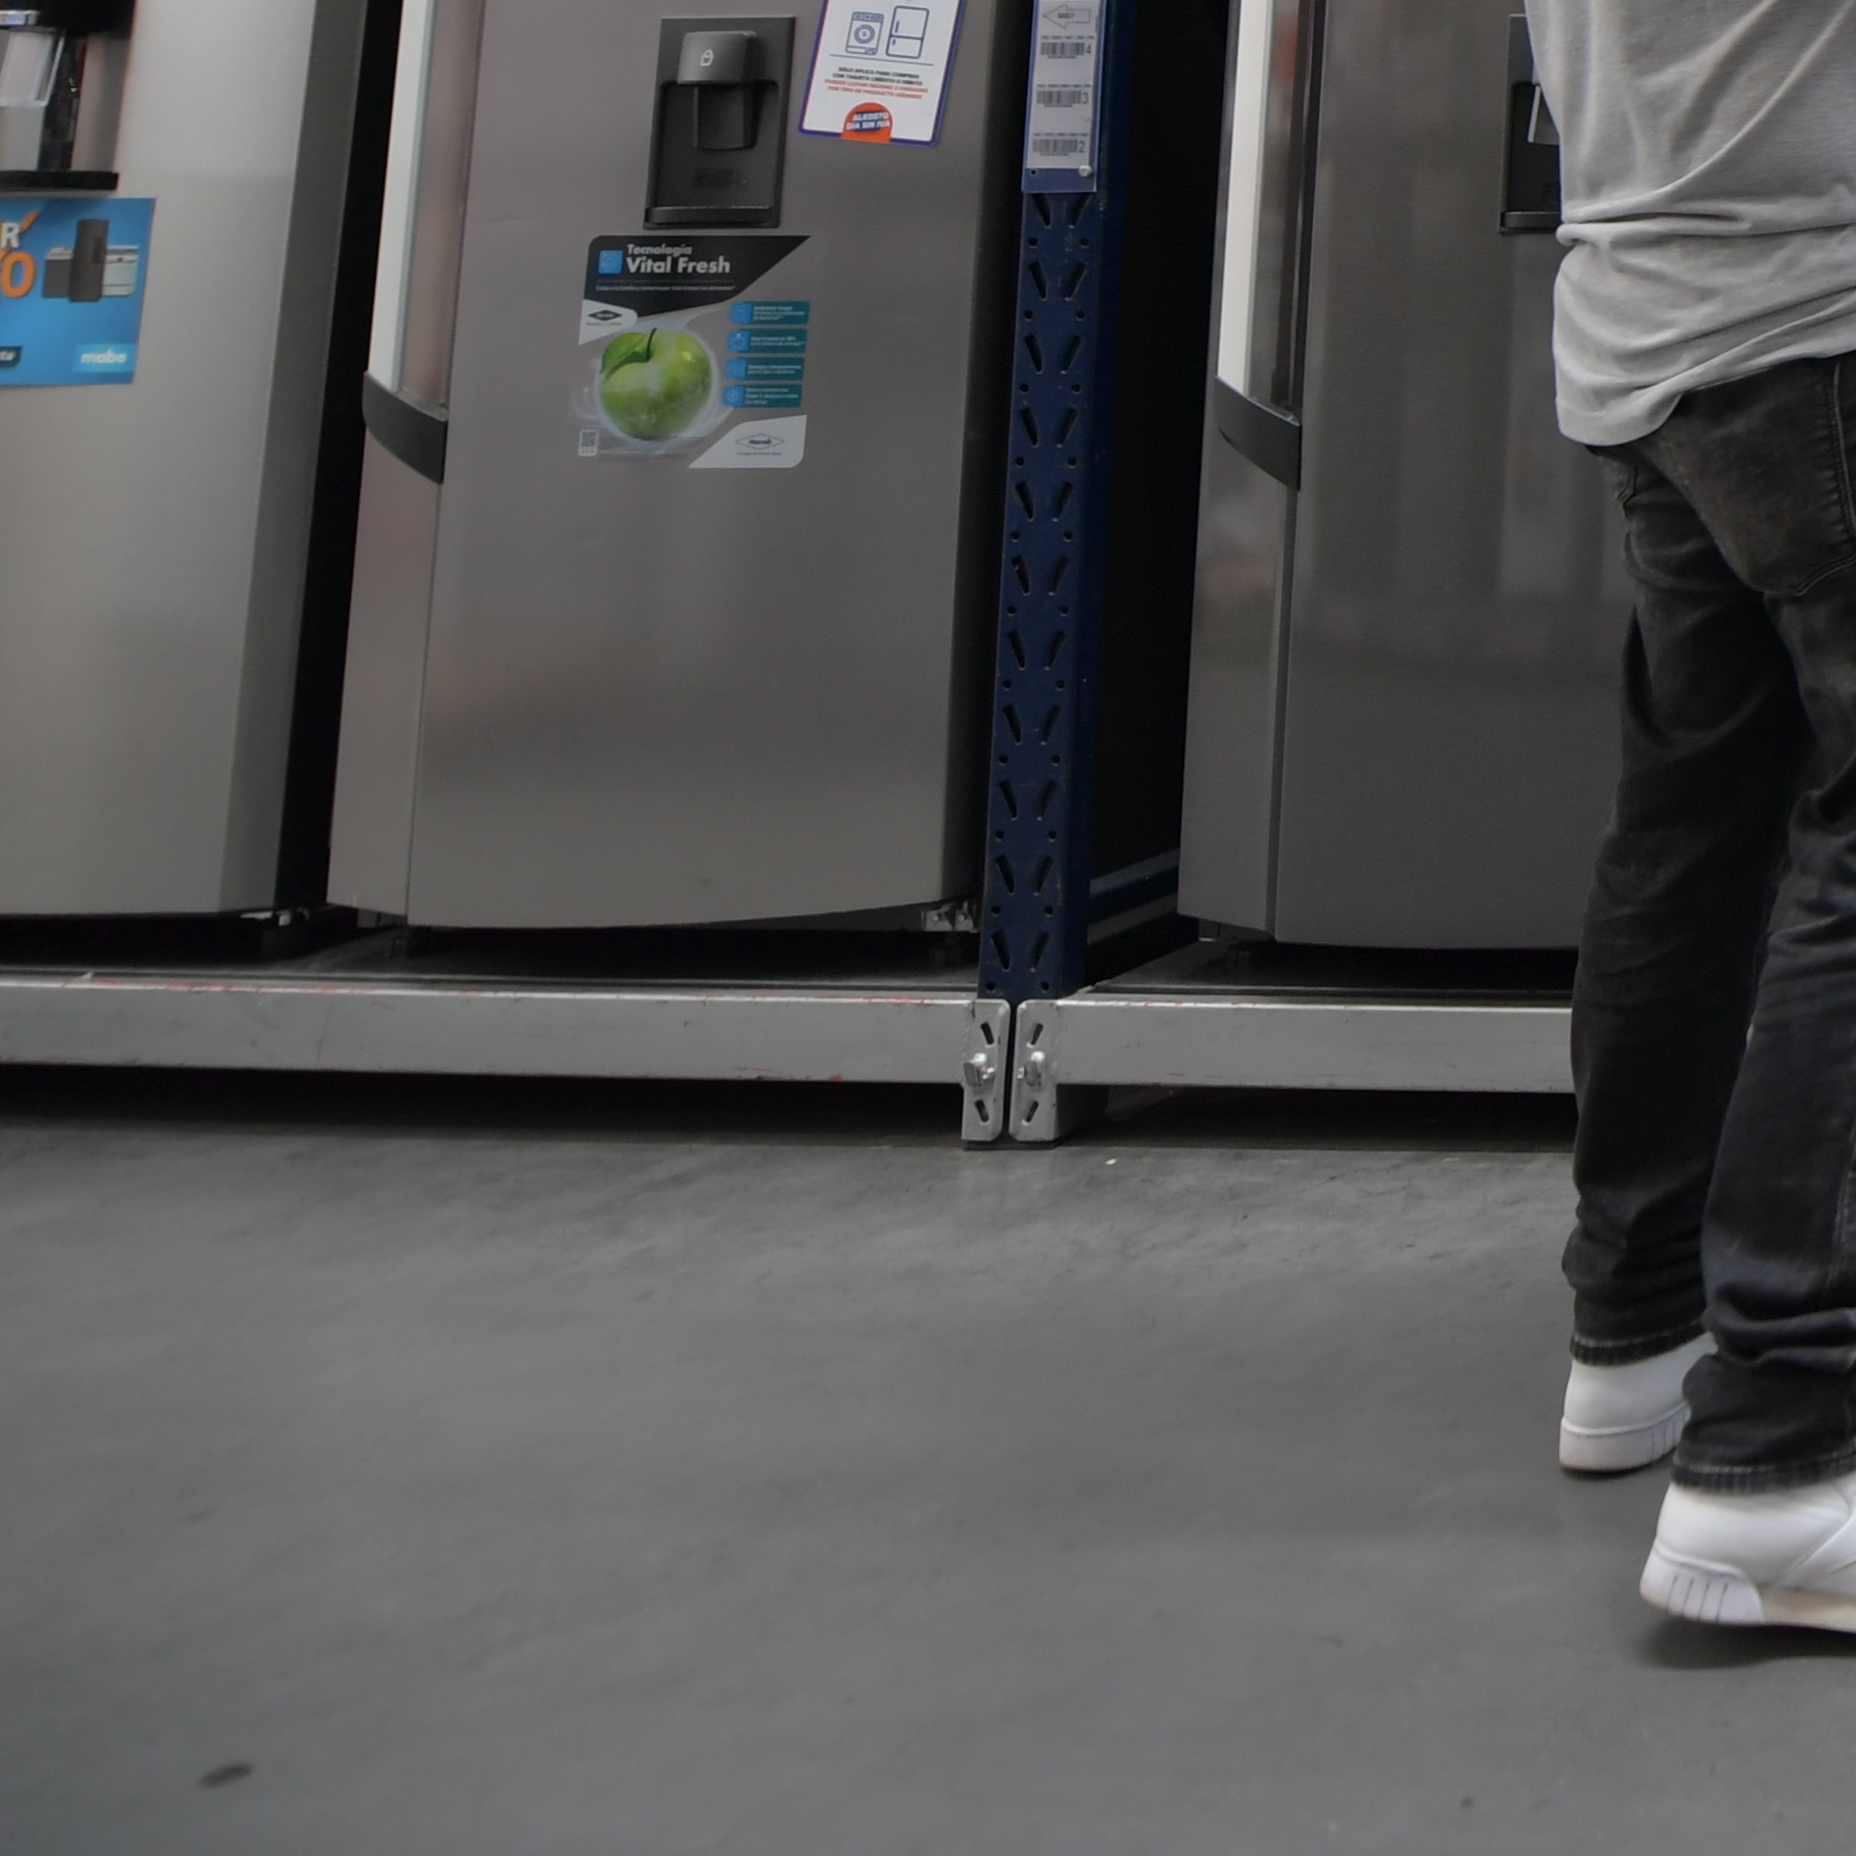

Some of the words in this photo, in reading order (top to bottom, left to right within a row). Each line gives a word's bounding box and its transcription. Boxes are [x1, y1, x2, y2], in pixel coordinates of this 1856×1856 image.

[626, 243, 693, 257] Tecnología
[626, 256, 671, 274] Vital
[676, 256, 731, 274] Fresh
[80, 349, 128, 365] mabe
